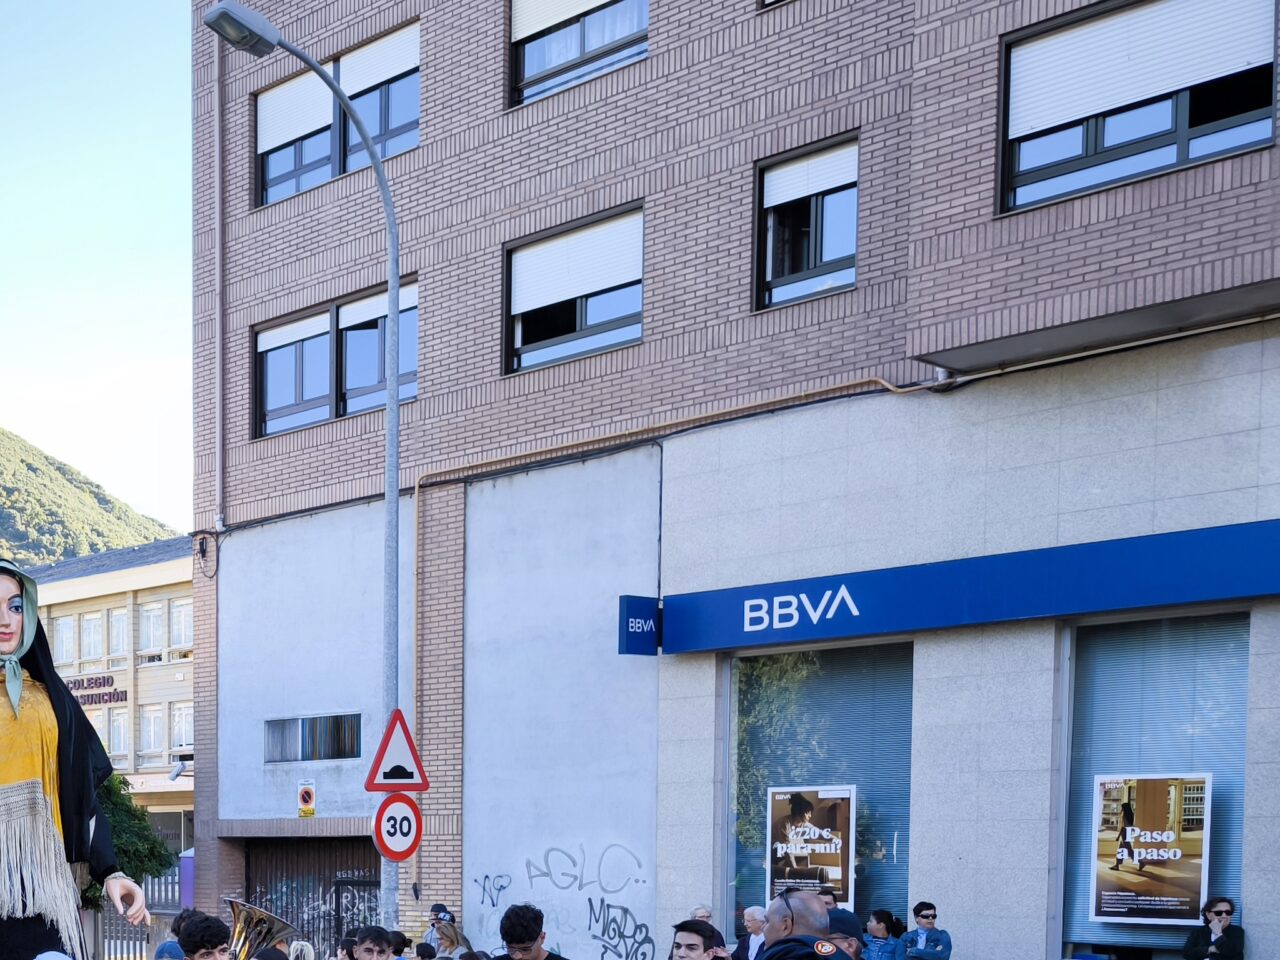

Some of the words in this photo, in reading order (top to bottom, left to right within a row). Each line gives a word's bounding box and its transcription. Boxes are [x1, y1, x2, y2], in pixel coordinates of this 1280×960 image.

[743, 584, 860, 632] BBVA
[628, 618, 656, 632] BBVA
[66, 675, 115, 691] COLEGIO
[75, 689, 128, 706] SUNCIÓN
[386, 815, 412, 838] 30
[1124, 826, 1176, 842] Paso
[776, 842, 812, 858] para
[1116, 847, 1129, 860] a
[1132, 847, 1182, 864] paso
